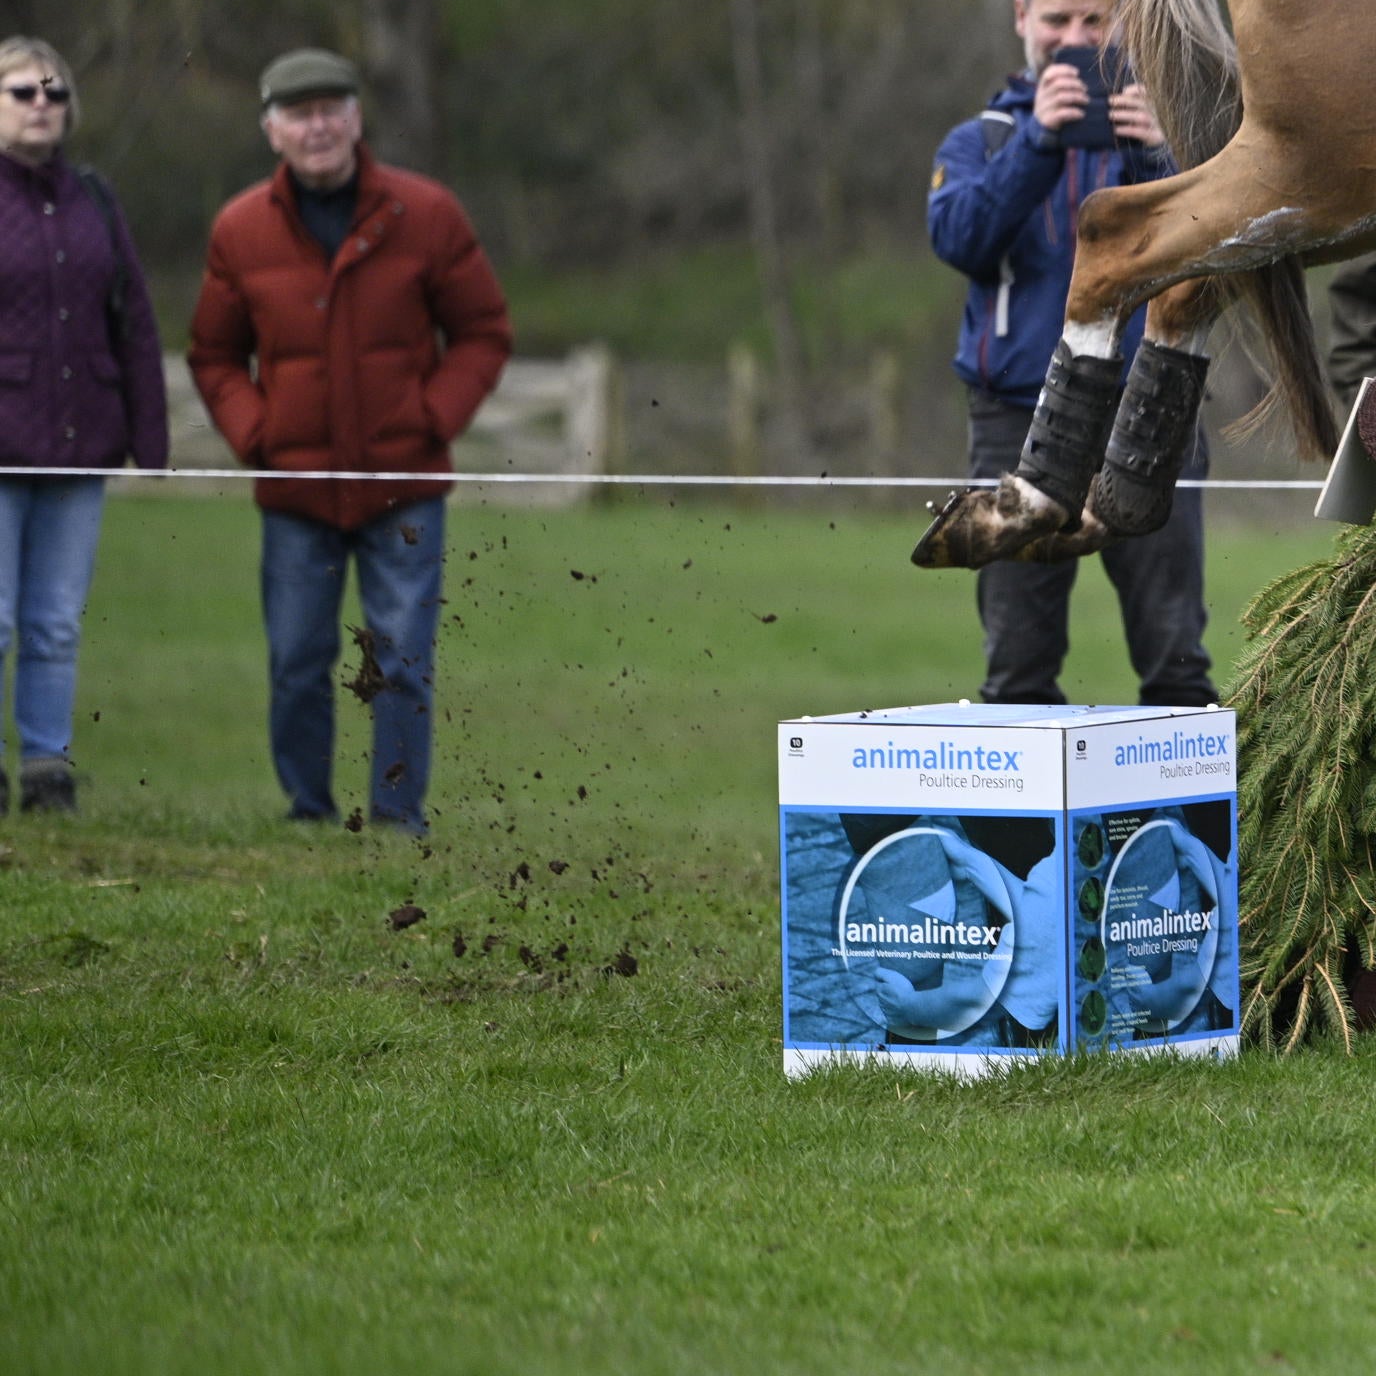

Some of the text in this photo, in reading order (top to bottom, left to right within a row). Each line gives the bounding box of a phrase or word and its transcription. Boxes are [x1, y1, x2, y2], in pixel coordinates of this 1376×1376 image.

[852, 741, 1019, 771] animalintex
[1115, 731, 1228, 766] animalintex
[1160, 760, 1230, 779] Poultice Dressing
[919, 773, 1024, 792] Poultice Dressing
[846, 917, 998, 946] animalintex
[1110, 909, 1212, 941] animalintex
[845, 948, 875, 958] Licensed
[876, 949, 912, 960] Veterinary
[912, 950, 940, 959] Poultice
[941, 951, 955, 959] and
[956, 952, 982, 960] Wound
[1127, 936, 1198, 957] Poultice Dressing
